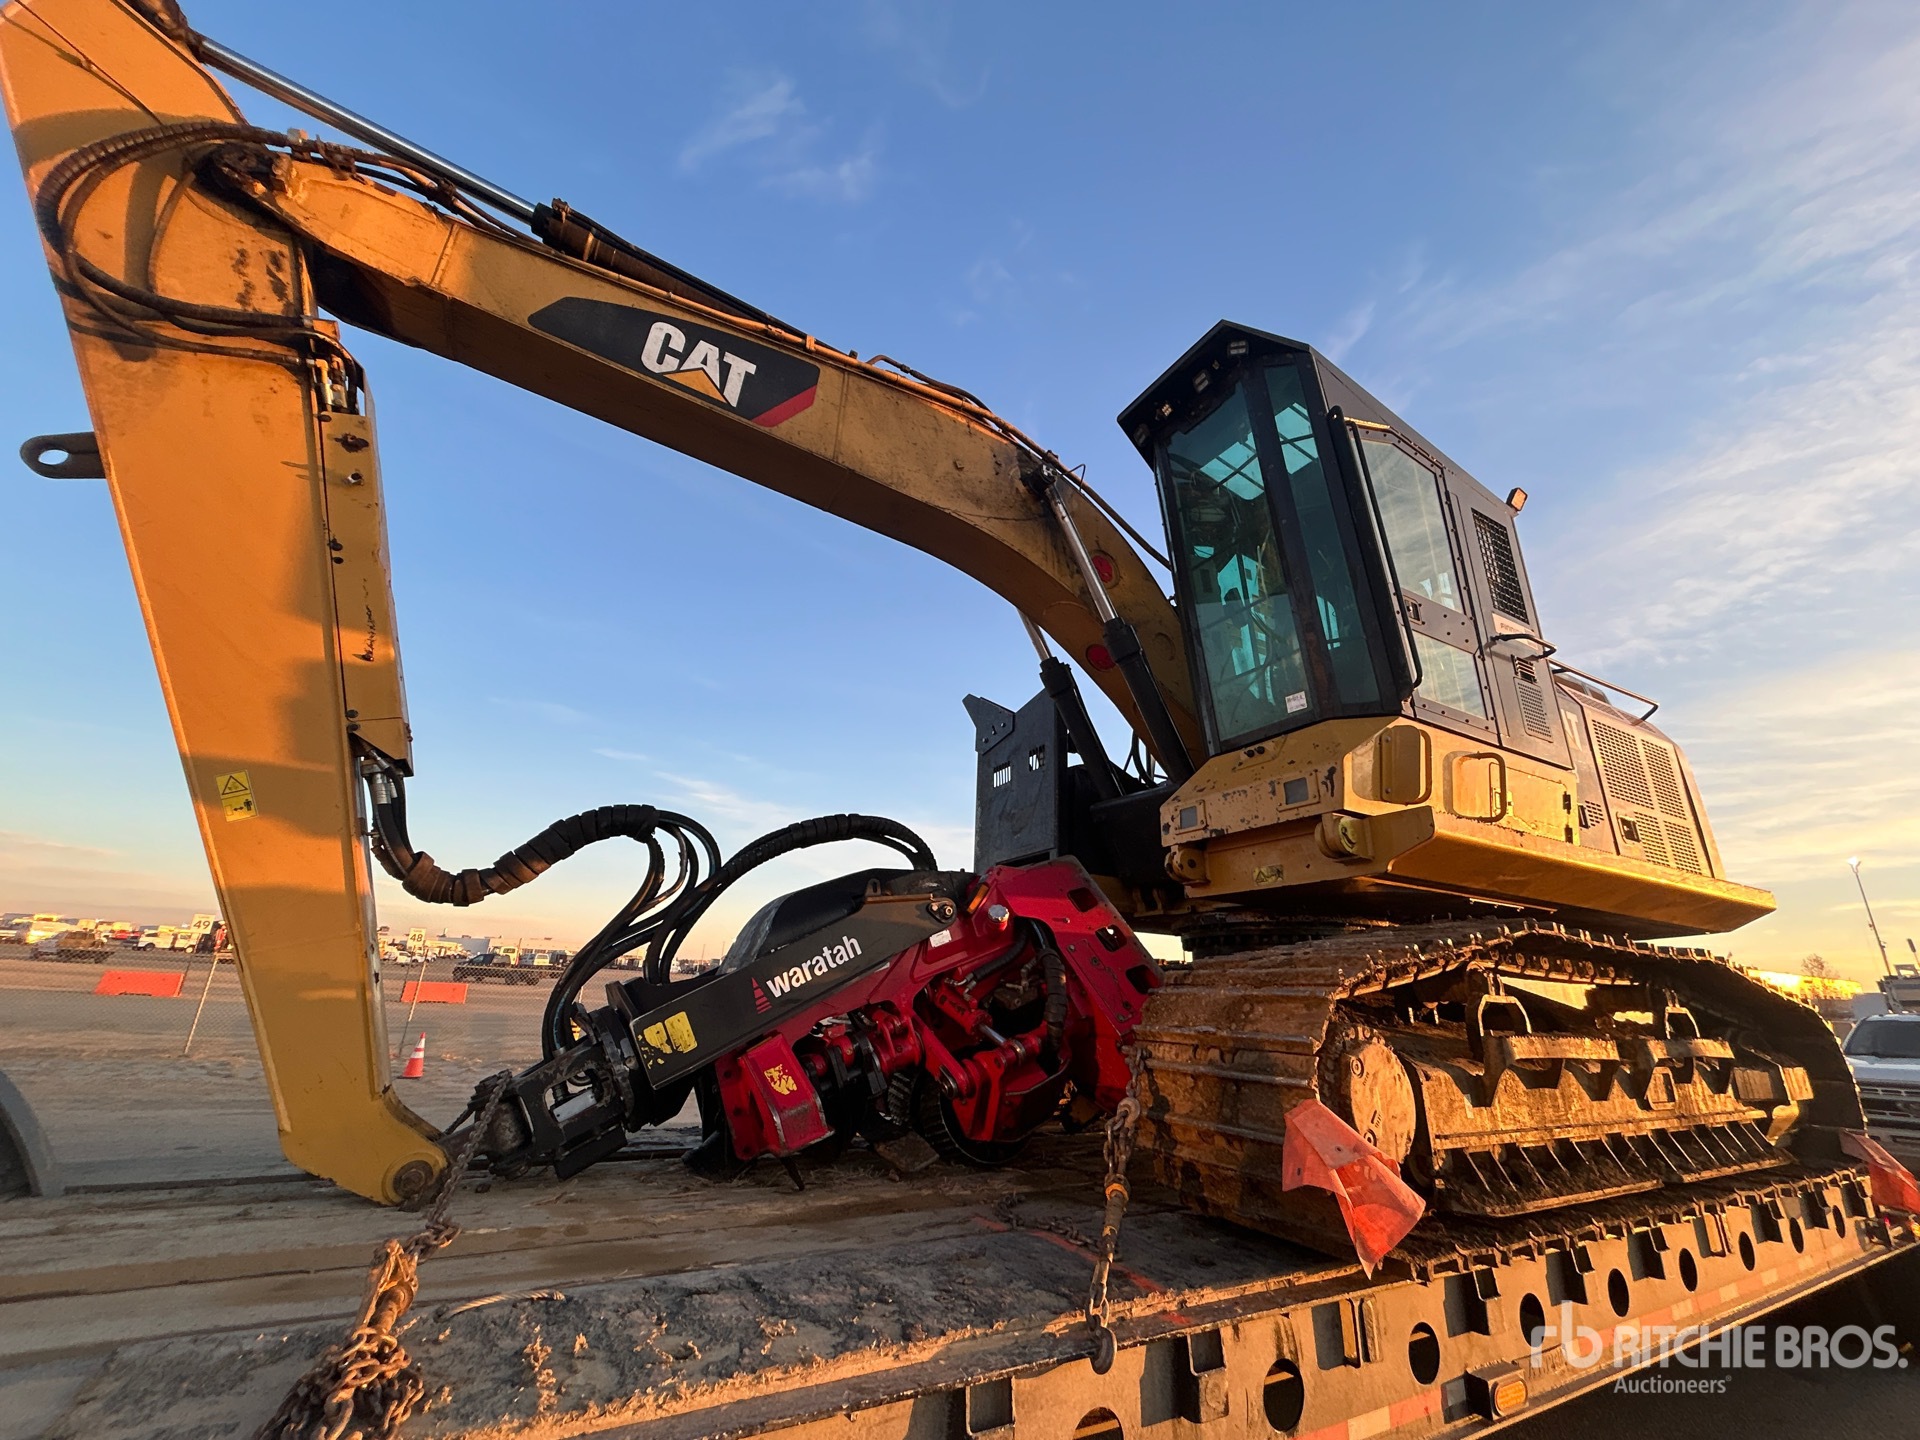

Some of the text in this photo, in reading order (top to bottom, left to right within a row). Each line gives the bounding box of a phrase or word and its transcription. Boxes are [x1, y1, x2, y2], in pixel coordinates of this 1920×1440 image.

[641, 321, 757, 408] CAT
[193, 920, 211, 929] 49
[410, 933, 423, 942] 48
[766, 935, 862, 998] waratah
